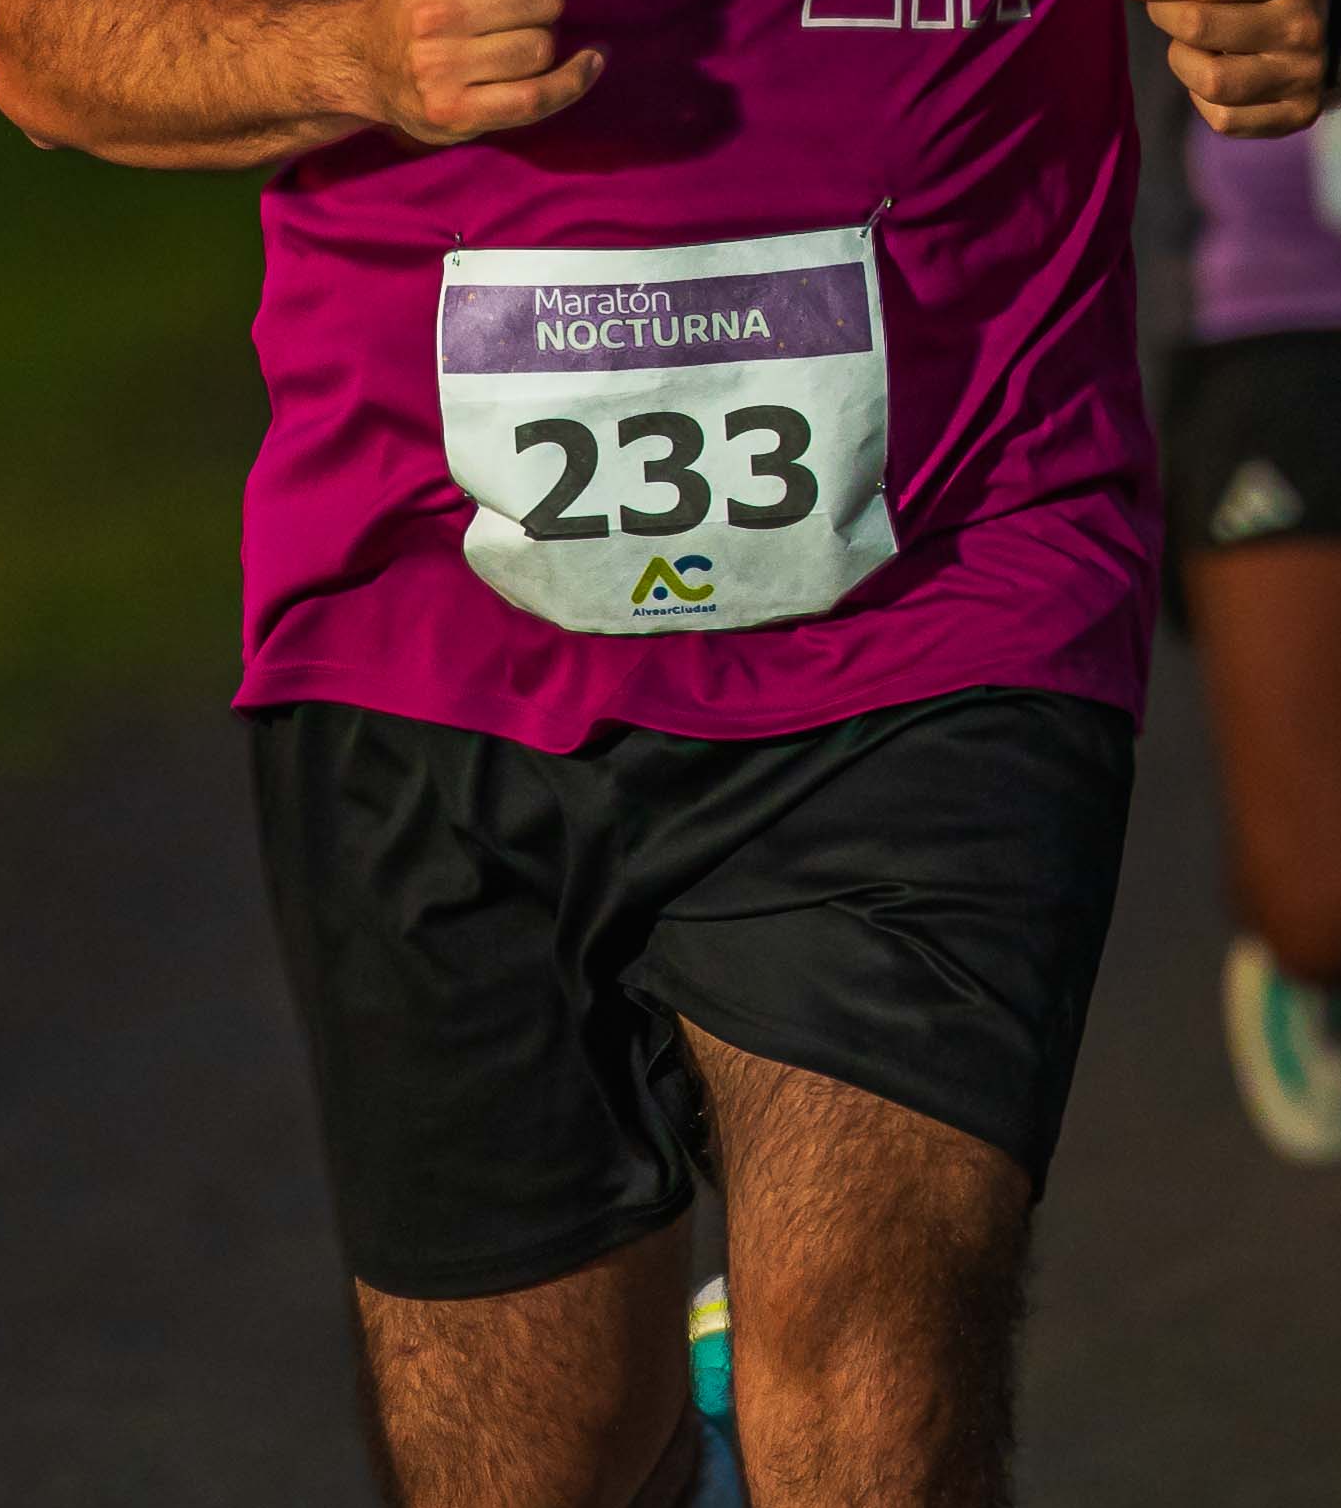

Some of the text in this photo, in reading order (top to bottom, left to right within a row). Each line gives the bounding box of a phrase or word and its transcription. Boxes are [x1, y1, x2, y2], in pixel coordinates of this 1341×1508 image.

[535, 283, 671, 316] Maratón
[536, 309, 771, 352] NOCTURNA
[514, 404, 819, 542] 233
